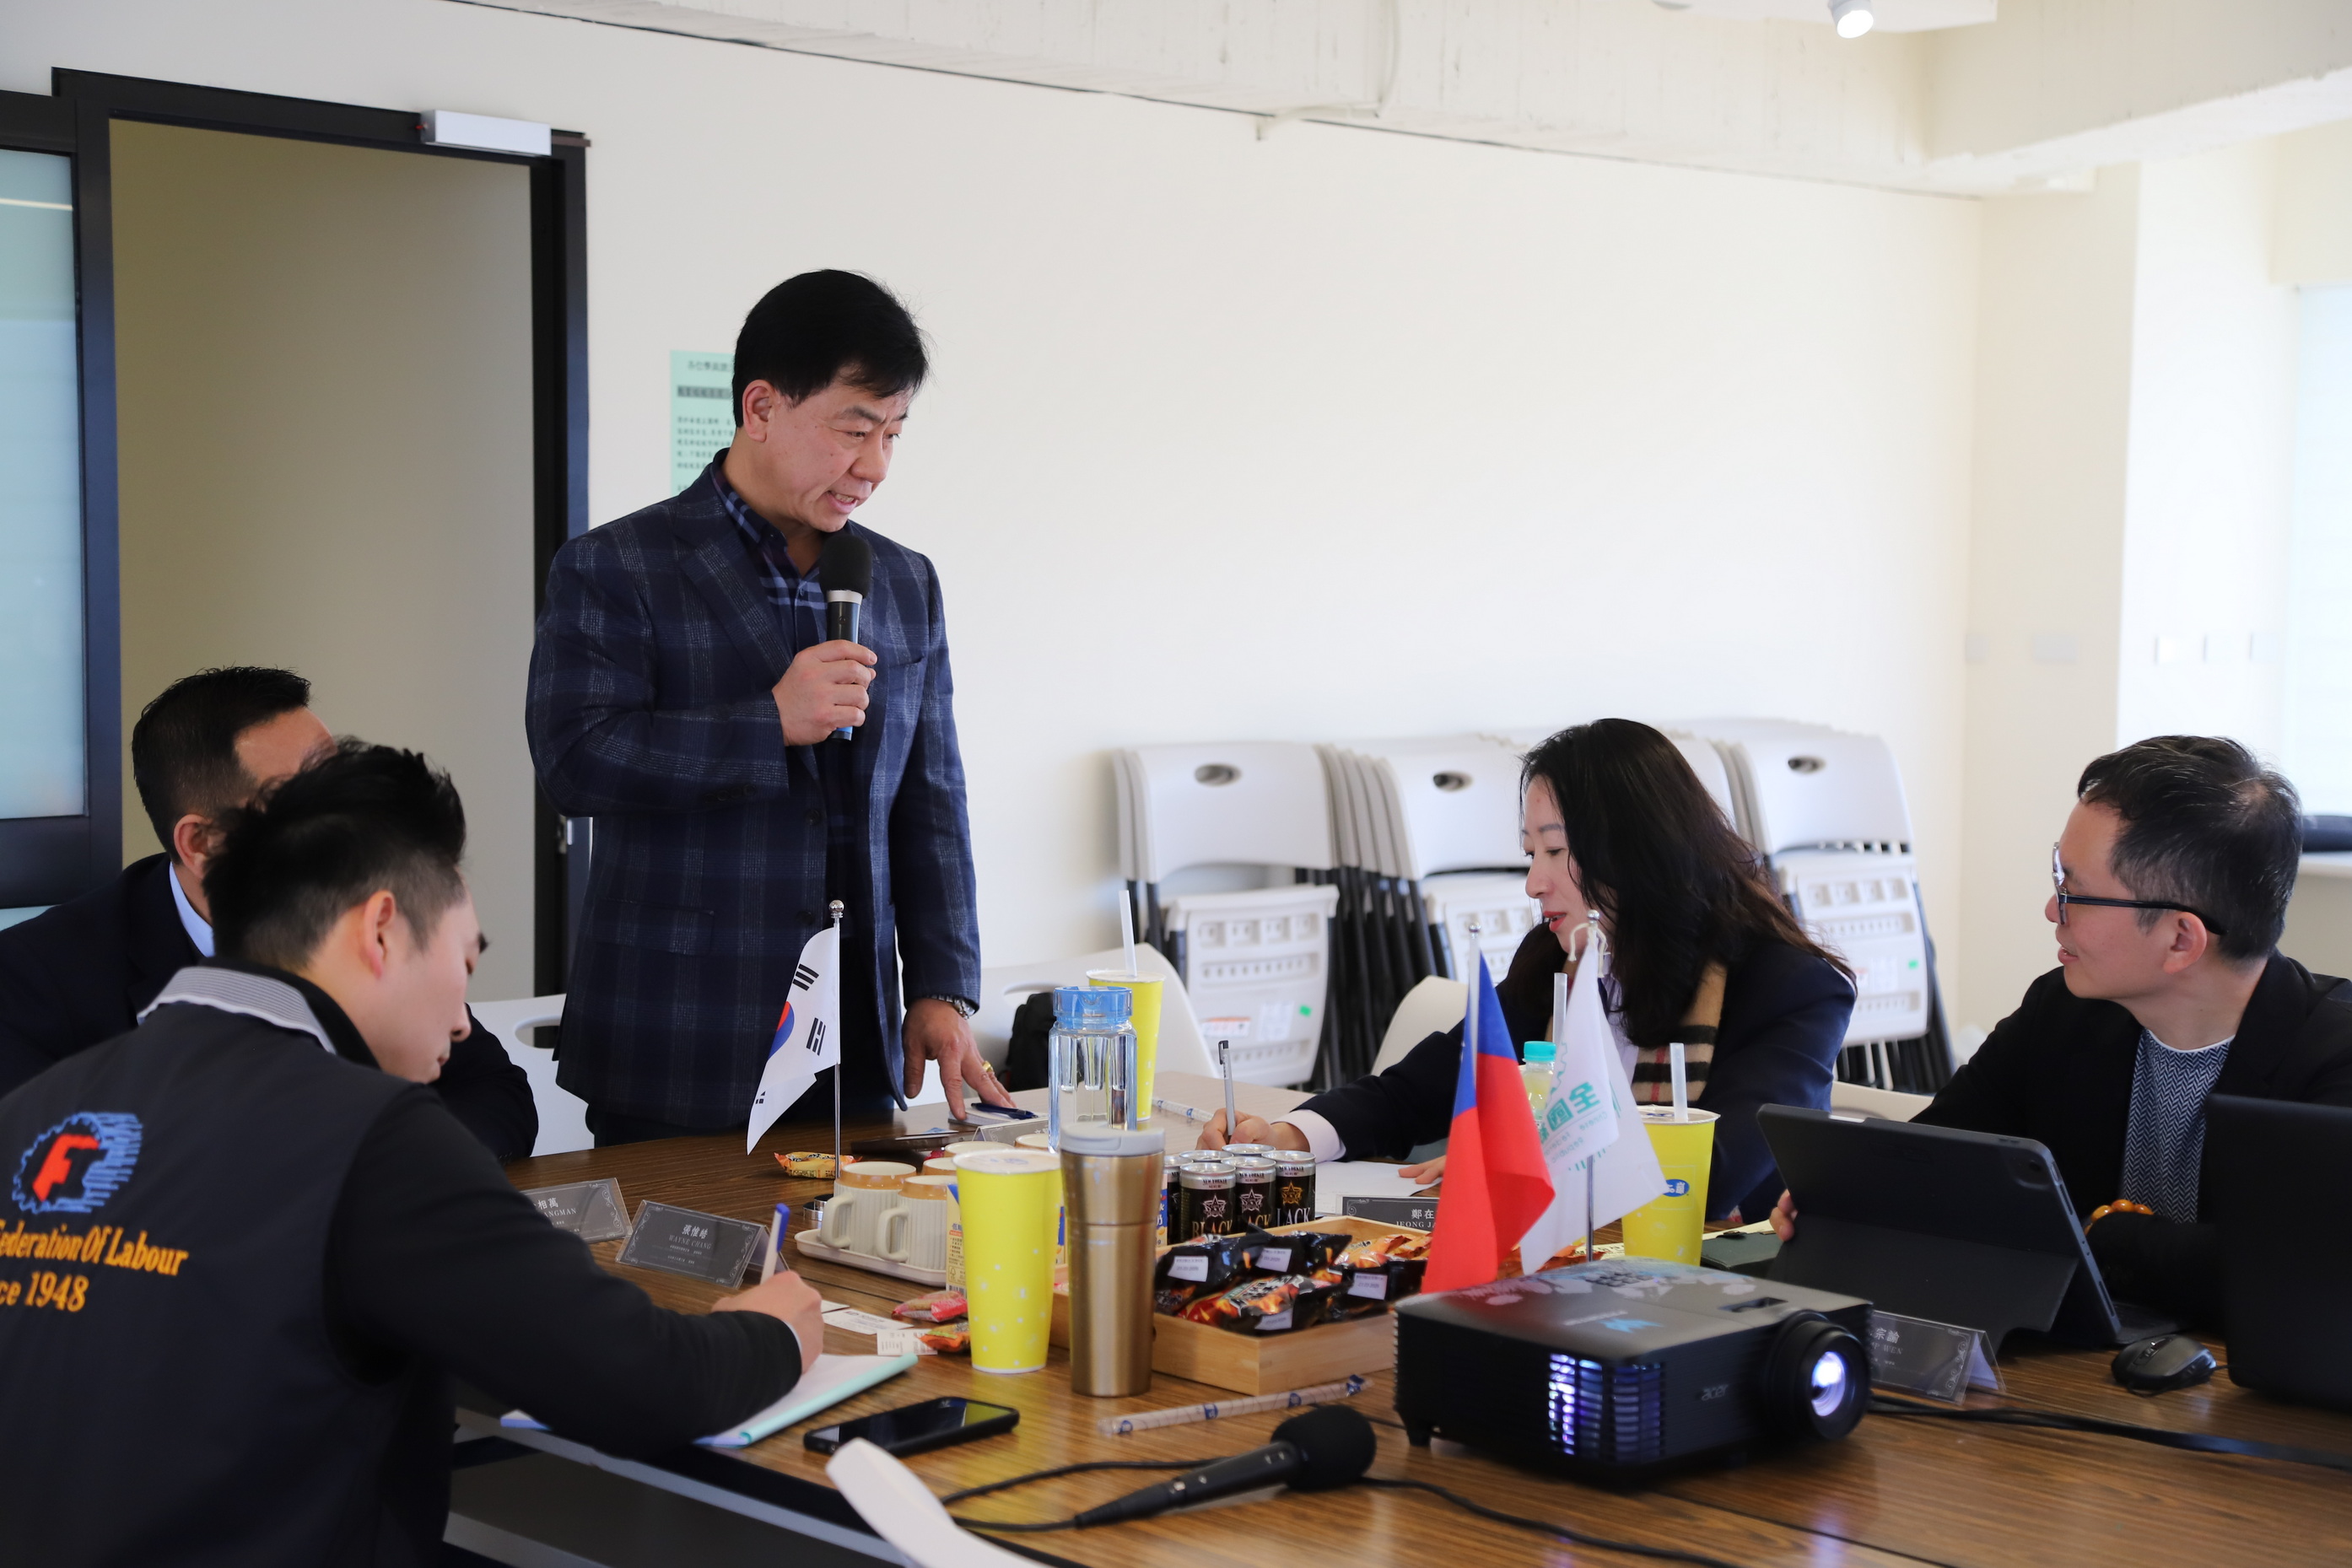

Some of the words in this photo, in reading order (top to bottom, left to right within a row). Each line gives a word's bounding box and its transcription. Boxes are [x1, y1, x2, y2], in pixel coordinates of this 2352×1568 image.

[533, 1198, 558, 1210] 相萬
[1276, 1207, 1310, 1226] LACK
[81, 1226, 112, 1264] Of
[103, 1226, 189, 1276] Labour
[668, 1234, 690, 1246] WAYNE
[691, 1240, 712, 1250] CHANG
[24, 1270, 89, 1312] 1948
[1869, 1327, 1900, 1344] 宗諭
